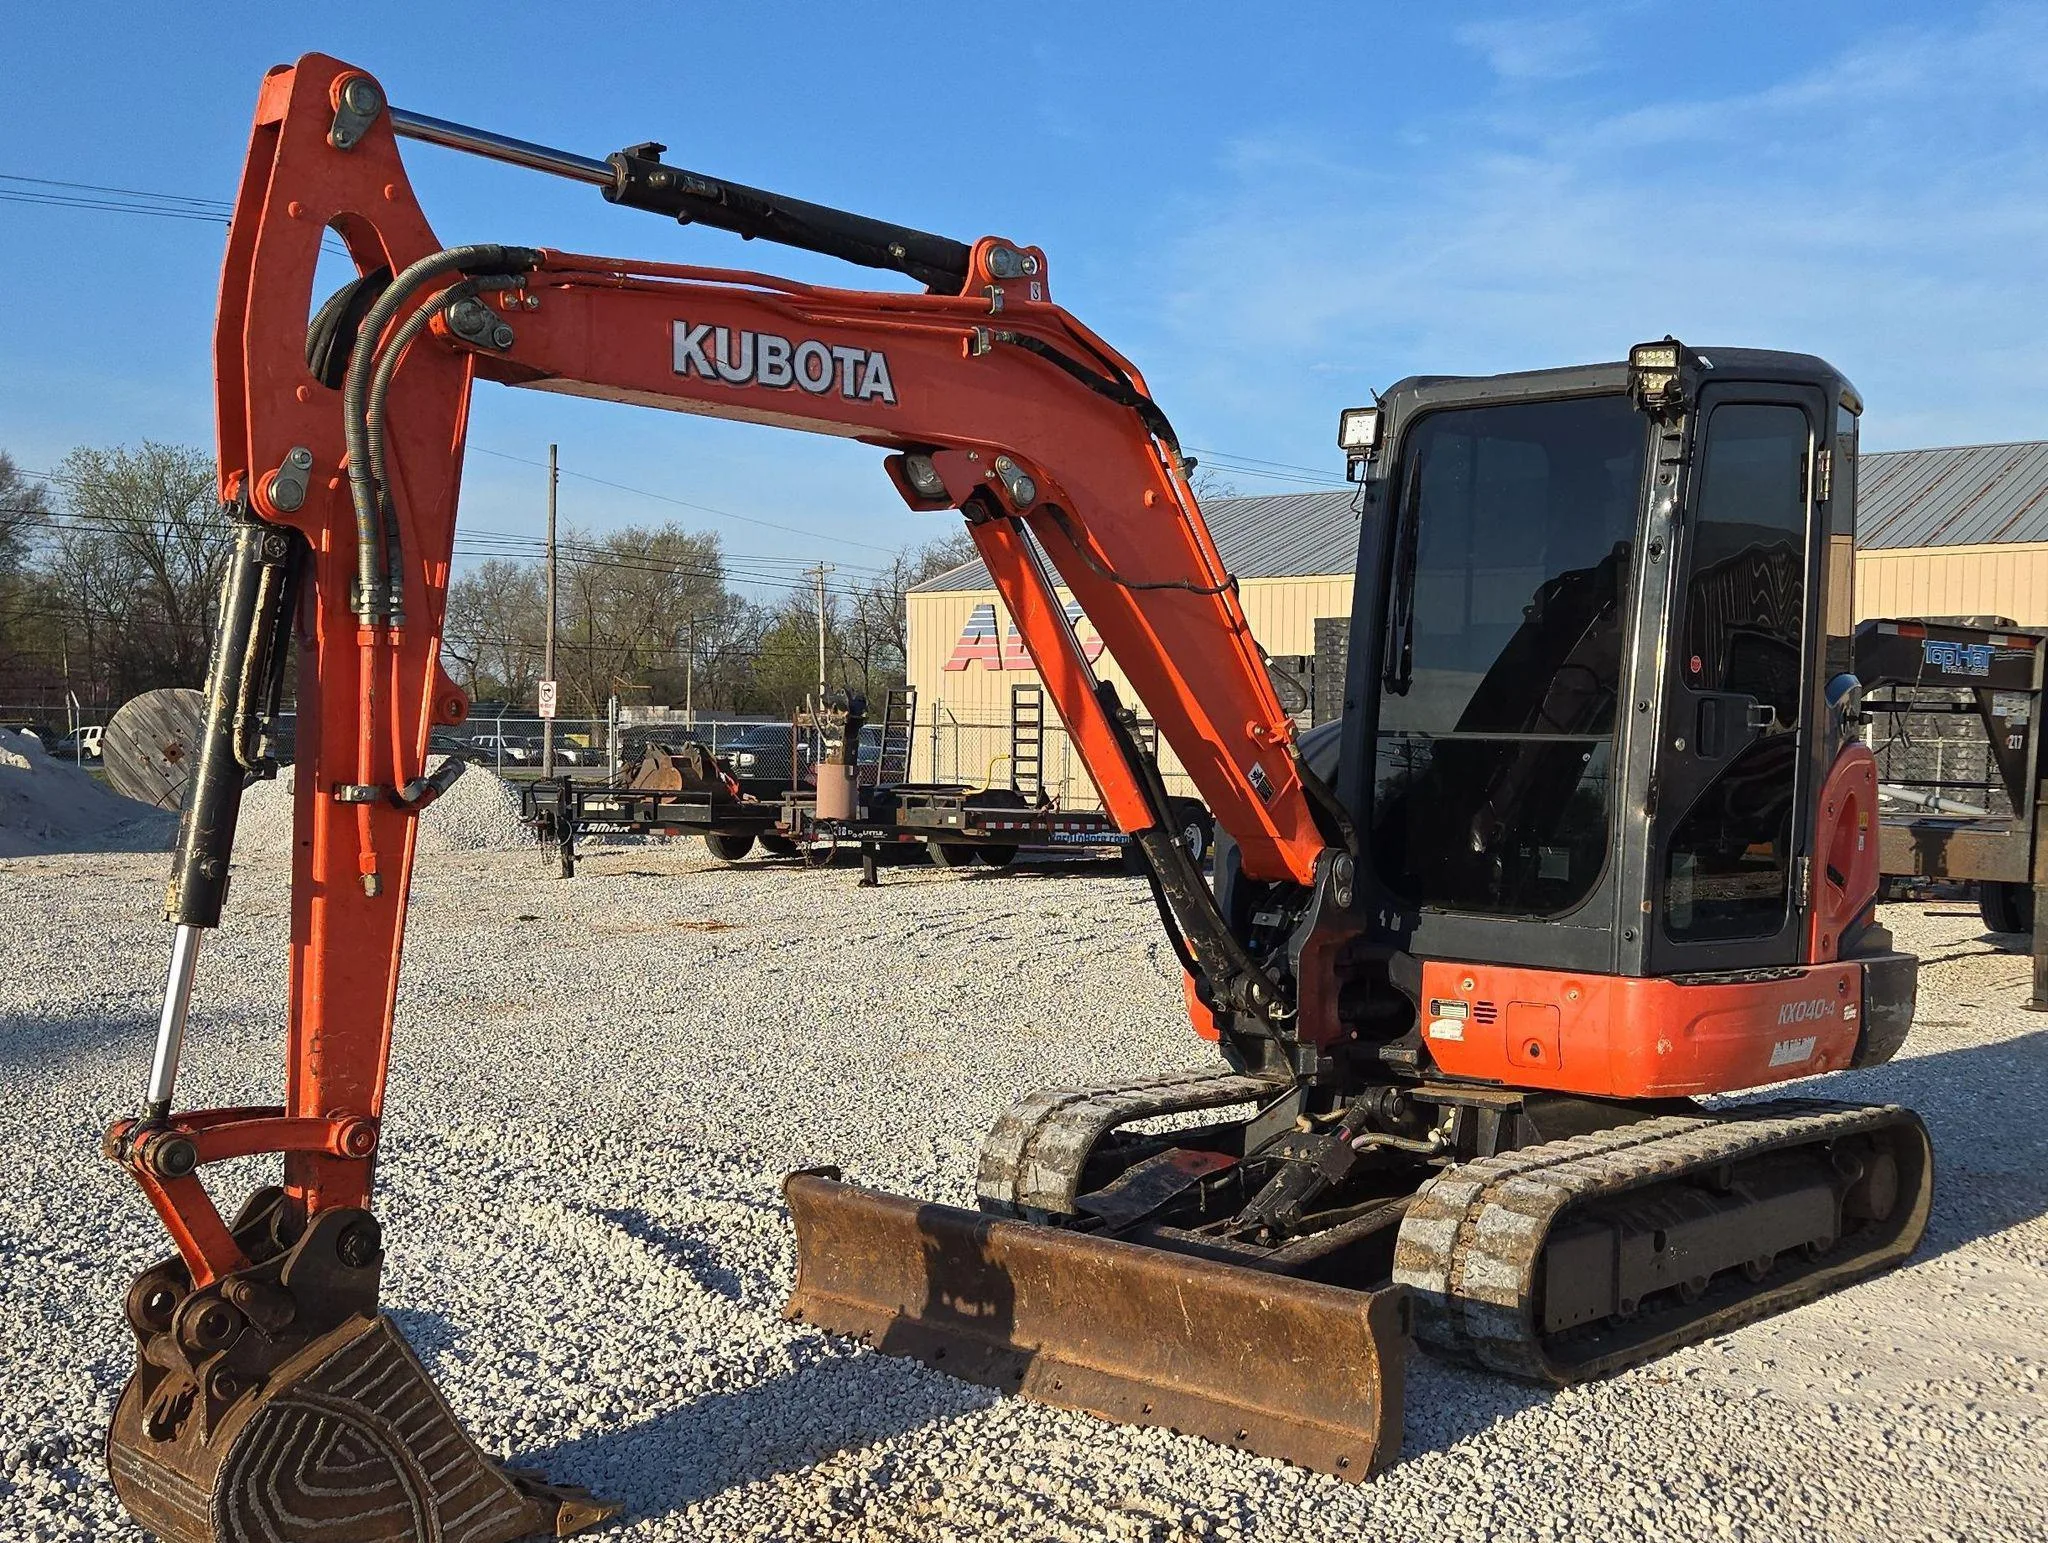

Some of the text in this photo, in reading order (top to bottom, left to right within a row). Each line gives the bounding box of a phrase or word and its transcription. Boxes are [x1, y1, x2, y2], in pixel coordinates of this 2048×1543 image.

[672, 320, 897, 404] KUBOTA
[2008, 734, 2023, 750] 217
[577, 823, 631, 833] LAMAR
[1778, 999, 1835, 1025] KX040-4
